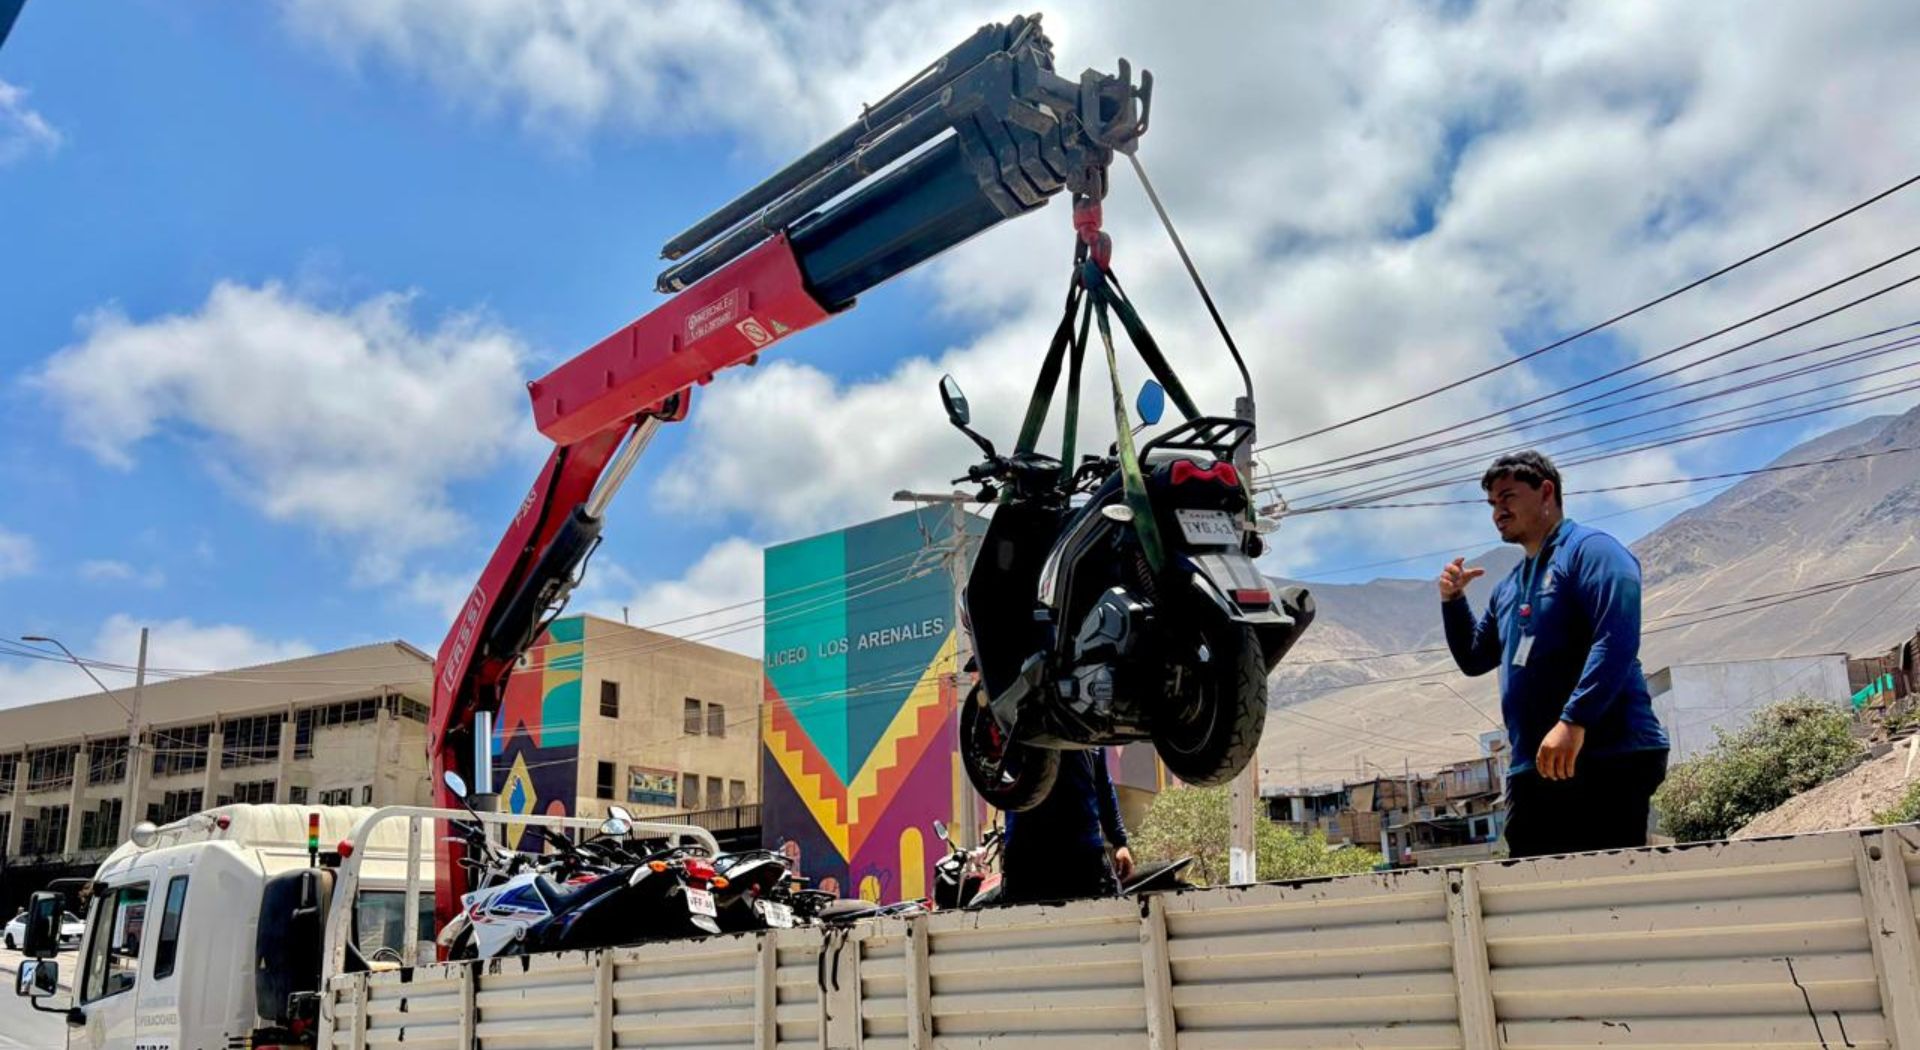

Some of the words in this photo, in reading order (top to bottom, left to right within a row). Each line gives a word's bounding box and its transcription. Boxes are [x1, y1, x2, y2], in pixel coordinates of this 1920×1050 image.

[446, 597, 482, 682] FASSI
[767, 646, 807, 668] LICEO
[818, 638, 849, 658] LOS
[857, 617, 944, 651] ARENALES
